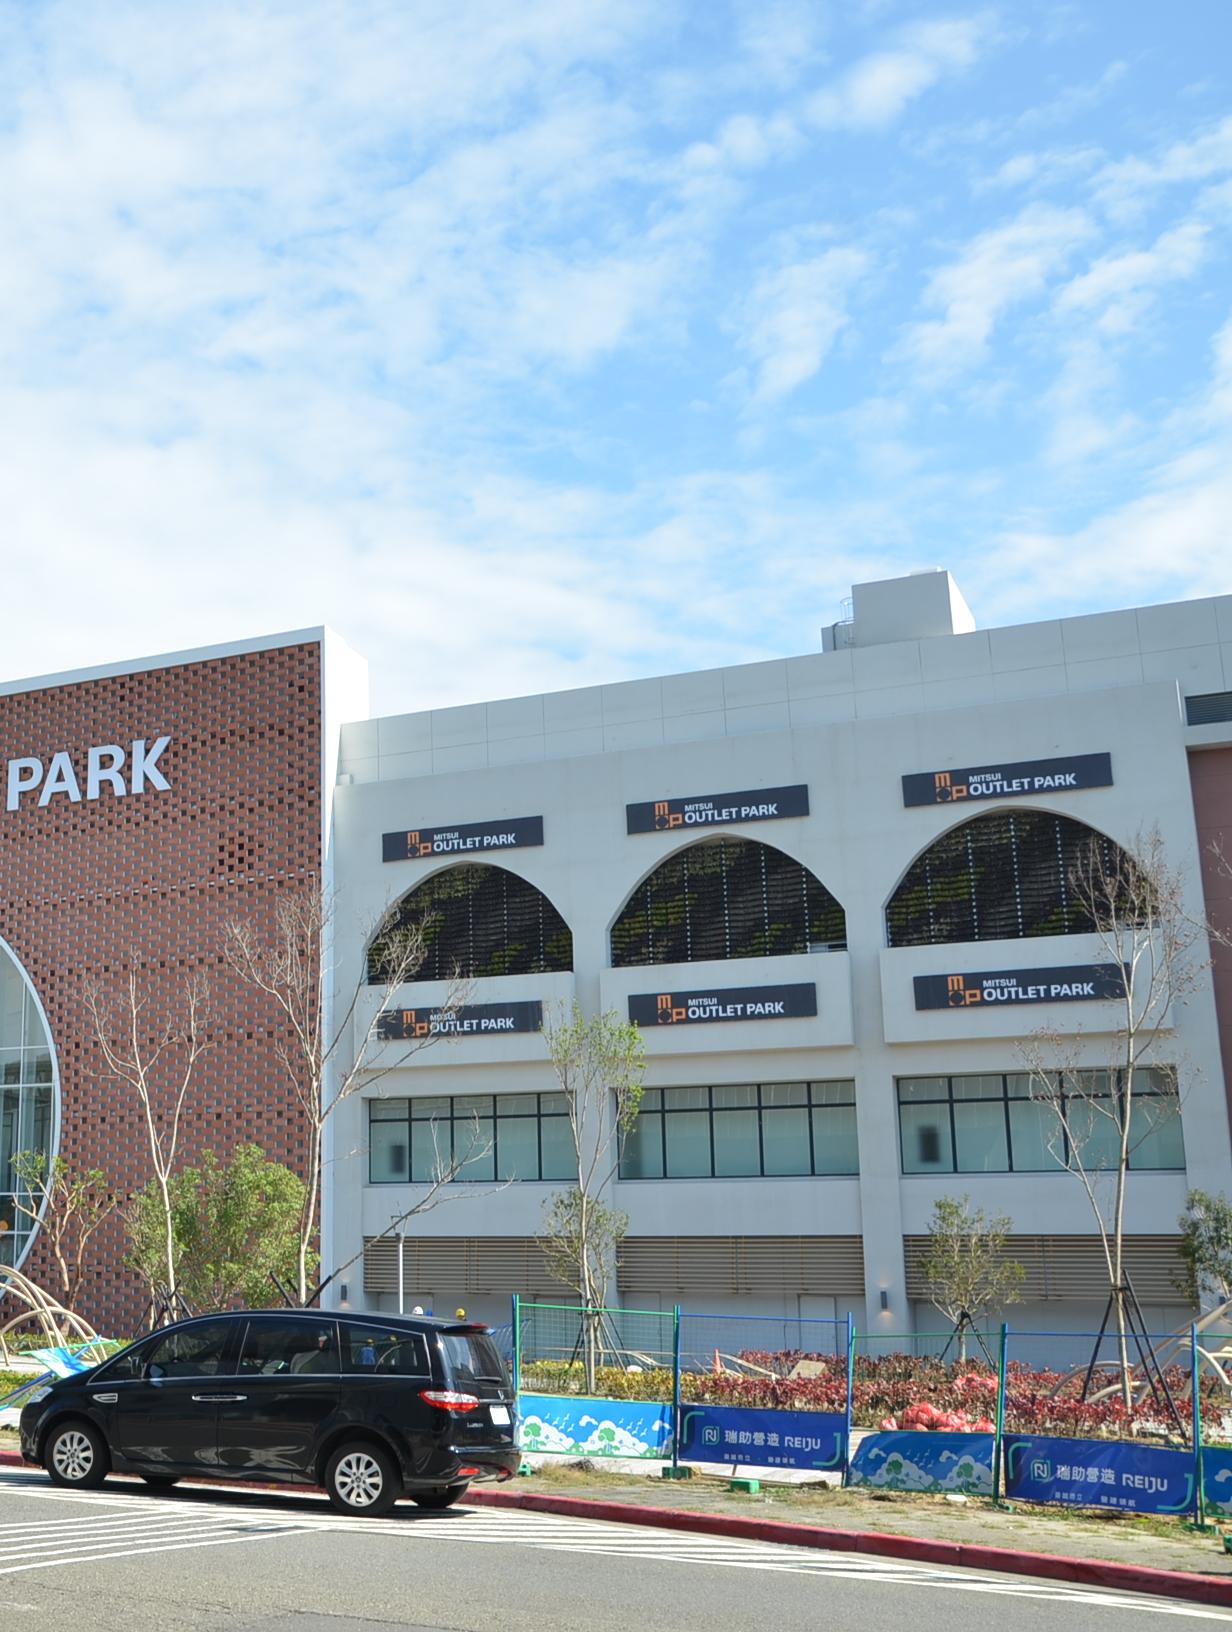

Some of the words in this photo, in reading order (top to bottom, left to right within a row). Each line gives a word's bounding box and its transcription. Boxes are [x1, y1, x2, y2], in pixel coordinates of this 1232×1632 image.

[6, 736, 172, 811] PARK
[969, 773, 1001, 783] MITSUI
[969, 778, 1031, 796] OUTLET
[1035, 773, 1076, 789] PARK
[685, 802, 713, 812] MITSUI
[685, 808, 738, 823] OUTLET
[741, 804, 778, 817] PARK
[434, 832, 459, 840] MITSUI
[434, 837, 480, 851] OUTLET
[484, 833, 516, 846] PARK
[983, 978, 1016, 988] MITSUI
[983, 986, 1047, 1000] OUTLET
[1051, 983, 1094, 997] PARK
[688, 998, 717, 1006] MITSUI
[688, 1004, 743, 1018] OUTLET
[746, 1002, 784, 1015] PARK
[430, 1020, 479, 1033] OUTLET
[481, 1018, 514, 1030] PARK
[724, 1430, 780, 1447] 瑞助營造
[784, 1436, 821, 1451] REIJU
[1056, 1464, 1116, 1485] 瑞助營造
[1122, 1474, 1167, 1493] REIJU
